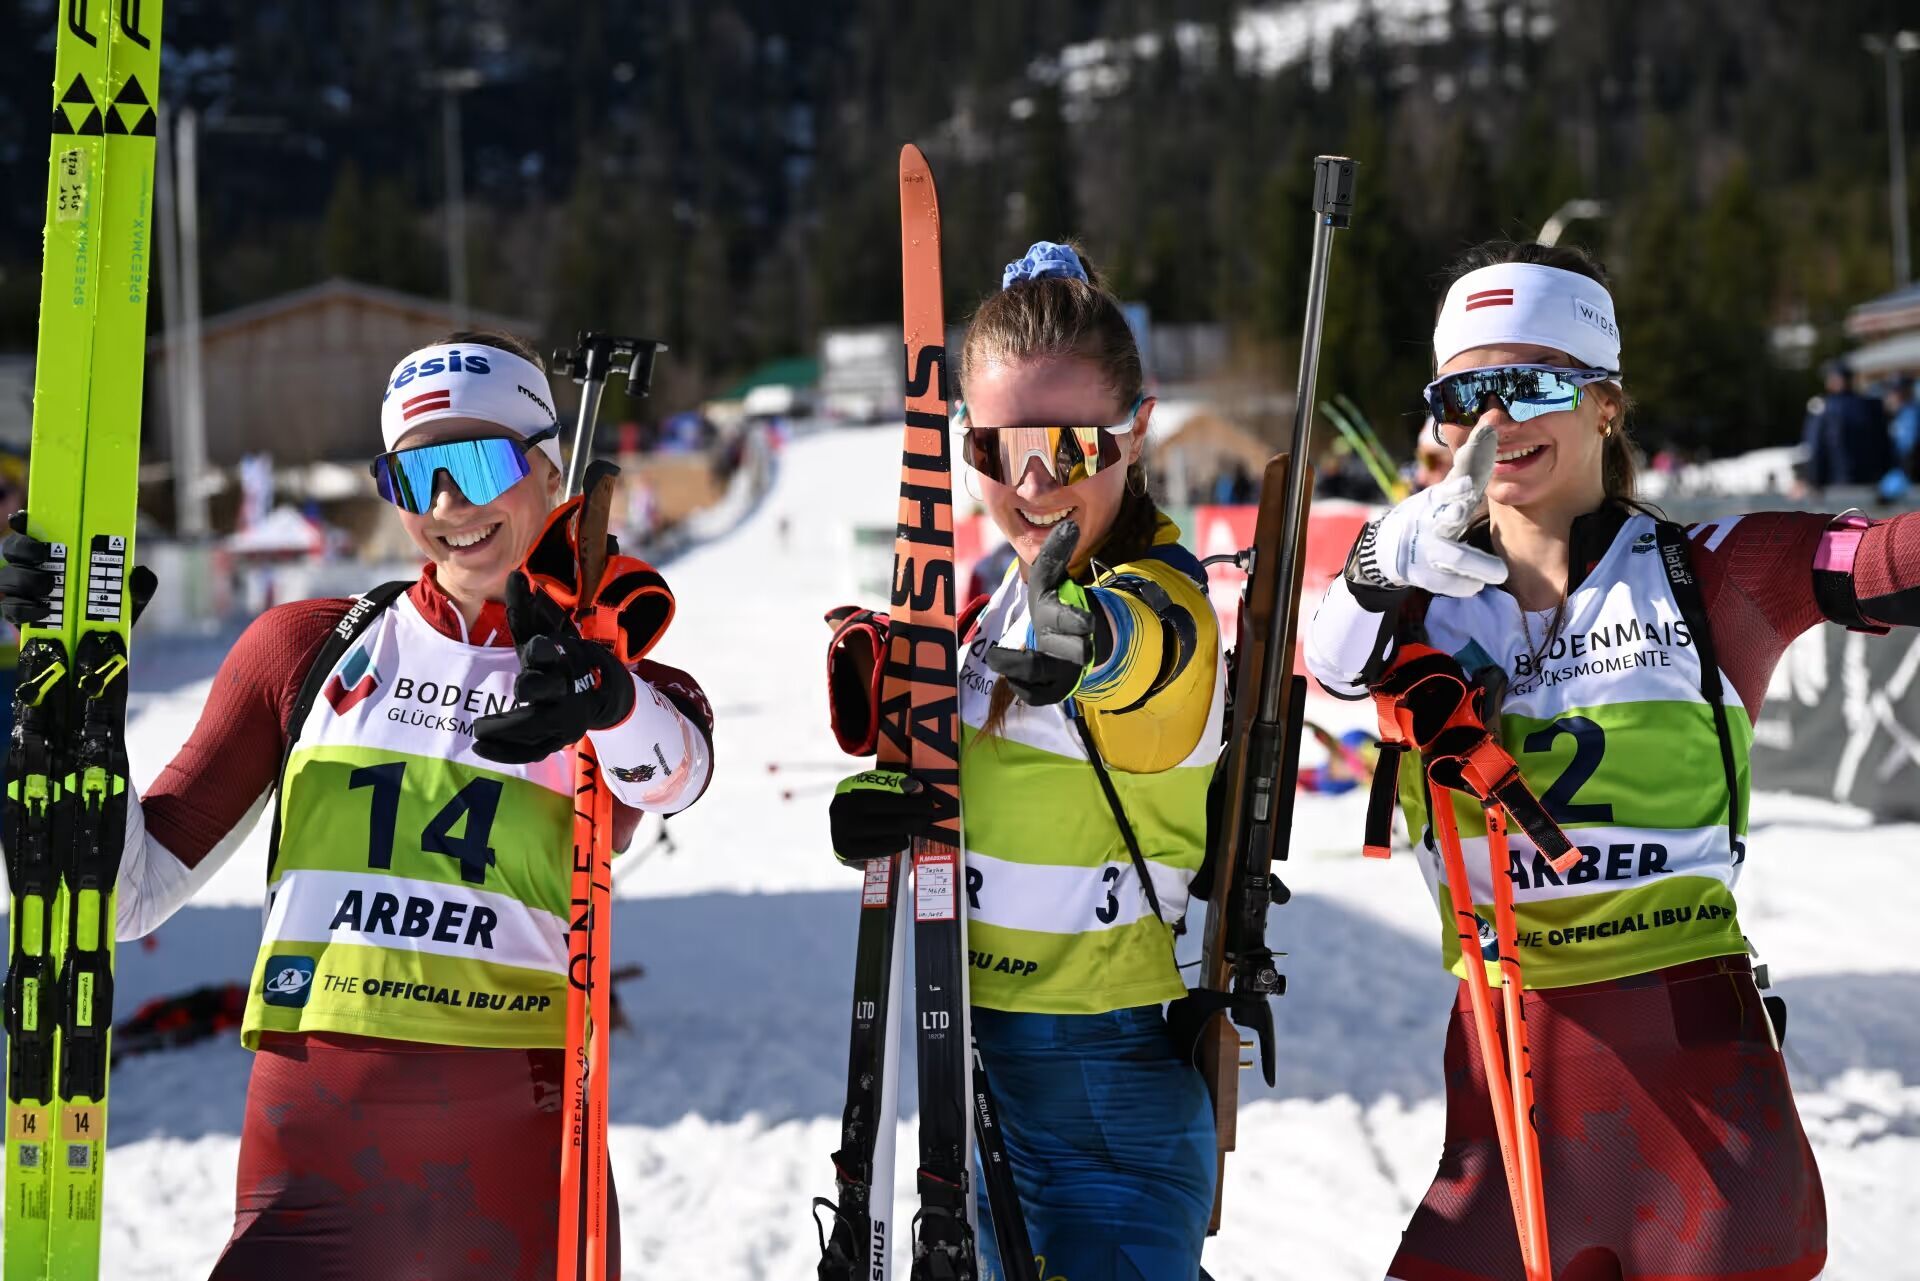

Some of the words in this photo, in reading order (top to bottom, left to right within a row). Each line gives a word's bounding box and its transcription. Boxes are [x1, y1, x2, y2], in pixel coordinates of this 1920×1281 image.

[129, 220, 144, 303] SPEEDMAX
[336, 598, 376, 640] biatar
[1523, 715, 1614, 824] 2
[349, 761, 504, 886] 14
[1095, 866, 1119, 924] 3
[328, 889, 498, 950] ARBER
[1517, 931, 1544, 948] HE
[1548, 914, 1649, 946] OFFICIAL
[1654, 906, 1692, 928] IBU
[1695, 904, 1731, 921] APP
[994, 957, 1038, 976] APP
[323, 974, 358, 994] THE
[362, 978, 462, 1007] OFFICIAL
[466, 991, 507, 1011] IBU
[508, 995, 551, 1012] APP
[856, 1001, 875, 1019] LTD
[922, 1011, 950, 1030] LTD
[22, 1113, 36, 1133] 14
[75, 1112, 90, 1133] 14
[976, 1093, 992, 1128] REDLINE
